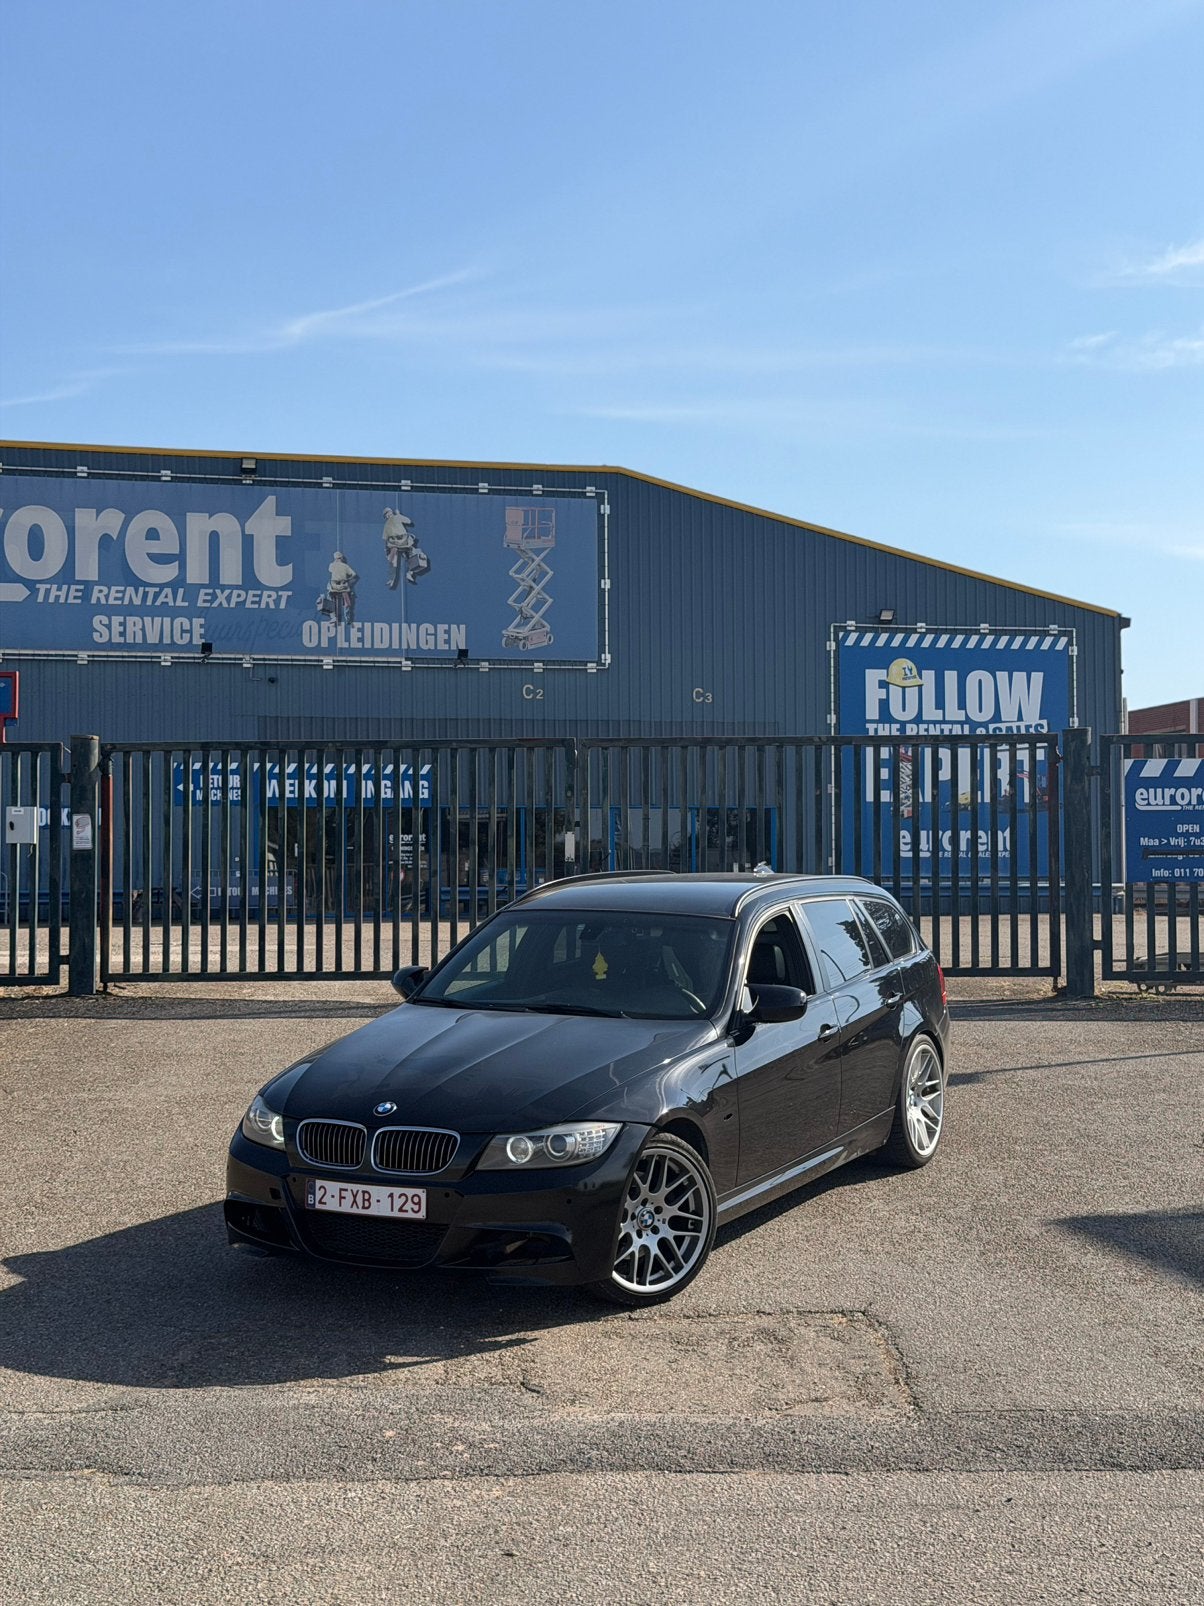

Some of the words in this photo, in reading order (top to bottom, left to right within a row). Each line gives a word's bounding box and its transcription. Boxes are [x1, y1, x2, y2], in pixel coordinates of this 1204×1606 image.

[0, 495, 293, 587] orent
[35, 584, 84, 604] THE
[91, 585, 189, 607] RENTAL
[197, 588, 293, 609] EXPERT
[92, 615, 206, 645] SERVICE
[302, 620, 466, 650] OPLEIDINGEN
[865, 668, 1044, 722] FOLLOW
[866, 746, 1046, 803] EPERT
[362, 780, 430, 799] INGNG
[1135, 788, 1204, 806] euror
[1177, 824, 1200, 833] OPEN
[1140, 837, 1159, 846] Maa
[1169, 837, 1188, 848] Vrij:
[1152, 868, 1172, 877] Info:
[1174, 868, 1190, 877] 011
[308, 1194, 314, 1204] B
[317, 1185, 422, 1214] 2-FXB-129
